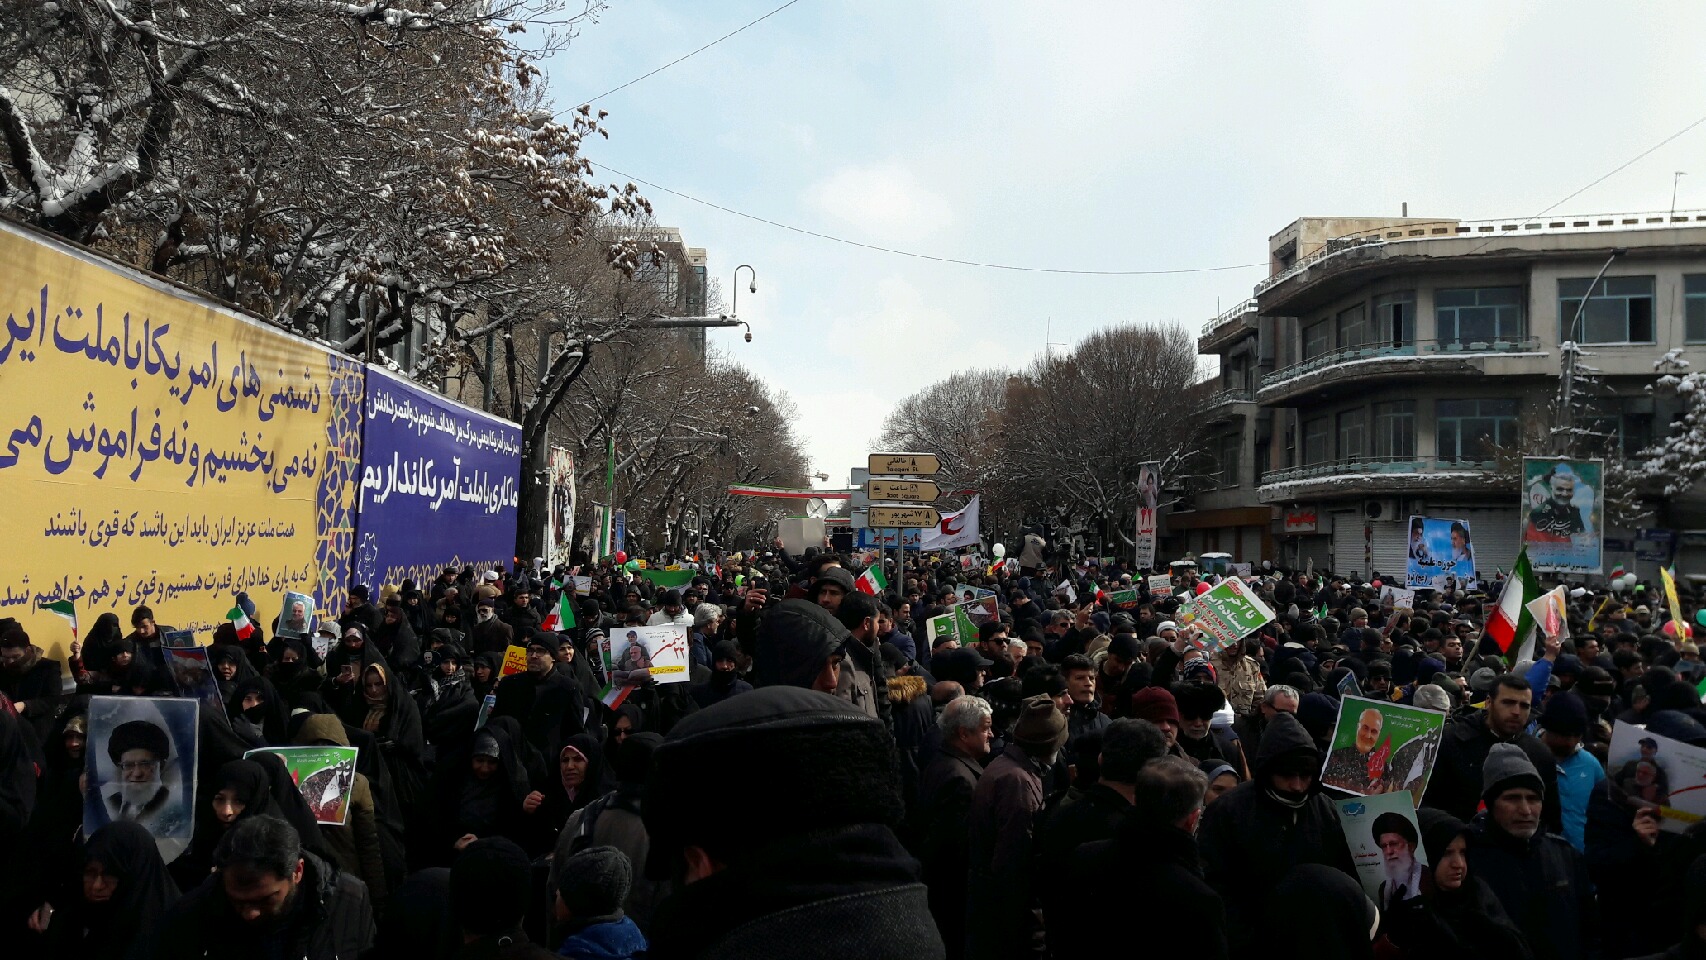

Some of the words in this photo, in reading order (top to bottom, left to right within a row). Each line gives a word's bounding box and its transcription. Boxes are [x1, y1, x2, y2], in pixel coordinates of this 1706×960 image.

[53, 302, 120, 366] ملت
[123, 312, 141, 389] با
[144, 318, 217, 405] امریکا
[216, 350, 261, 412] های
[259, 366, 320, 421] دشمنی
[44, 391, 161, 482] فراموش
[418, 408, 435, 436] شوم
[463, 420, 476, 446] مرگ
[163, 420, 188, 465] نه
[185, 442, 199, 487] و
[202, 431, 275, 489] بخشیم
[273, 456, 299, 493] می
[301, 442, 317, 478] نه
[358, 451, 418, 513] نداریم
[418, 456, 461, 512] آمریکا
[459, 469, 482, 504] ملت
[44, 507, 87, 544] باشند
[89, 510, 120, 547] قوی
[121, 511, 138, 536] که
[139, 511, 168, 544] باشد
[169, 513, 189, 547] این
[190, 514, 209, 544] باید
[210, 515, 236, 546] ایران
[235, 522, 256, 546] عزیز
[258, 517, 275, 537] ملت
[276, 522, 295, 537] همت
[128, 570, 156, 605] قوی
[165, 574, 202, 602] هستیم
[204, 566, 232, 599] قدرت
[231, 566, 256, 596] دارای
[257, 566, 270, 586] خدا
[291, 569, 299, 589] به
[300, 563, 309, 581] که
[0, 575, 30, 607] شد
[32, 575, 86, 615] خواهیم
[88, 579, 110, 609] هم
[111, 575, 128, 608] تر
[155, 582, 164, 604] و
[1192, 606, 1200, 615] TO
[1200, 615, 1212, 627] THE
[1212, 628, 1226, 641] END
[1196, 599, 1208, 609] WE
[1207, 609, 1228, 630] STAND
[1227, 630, 1238, 640] UP
